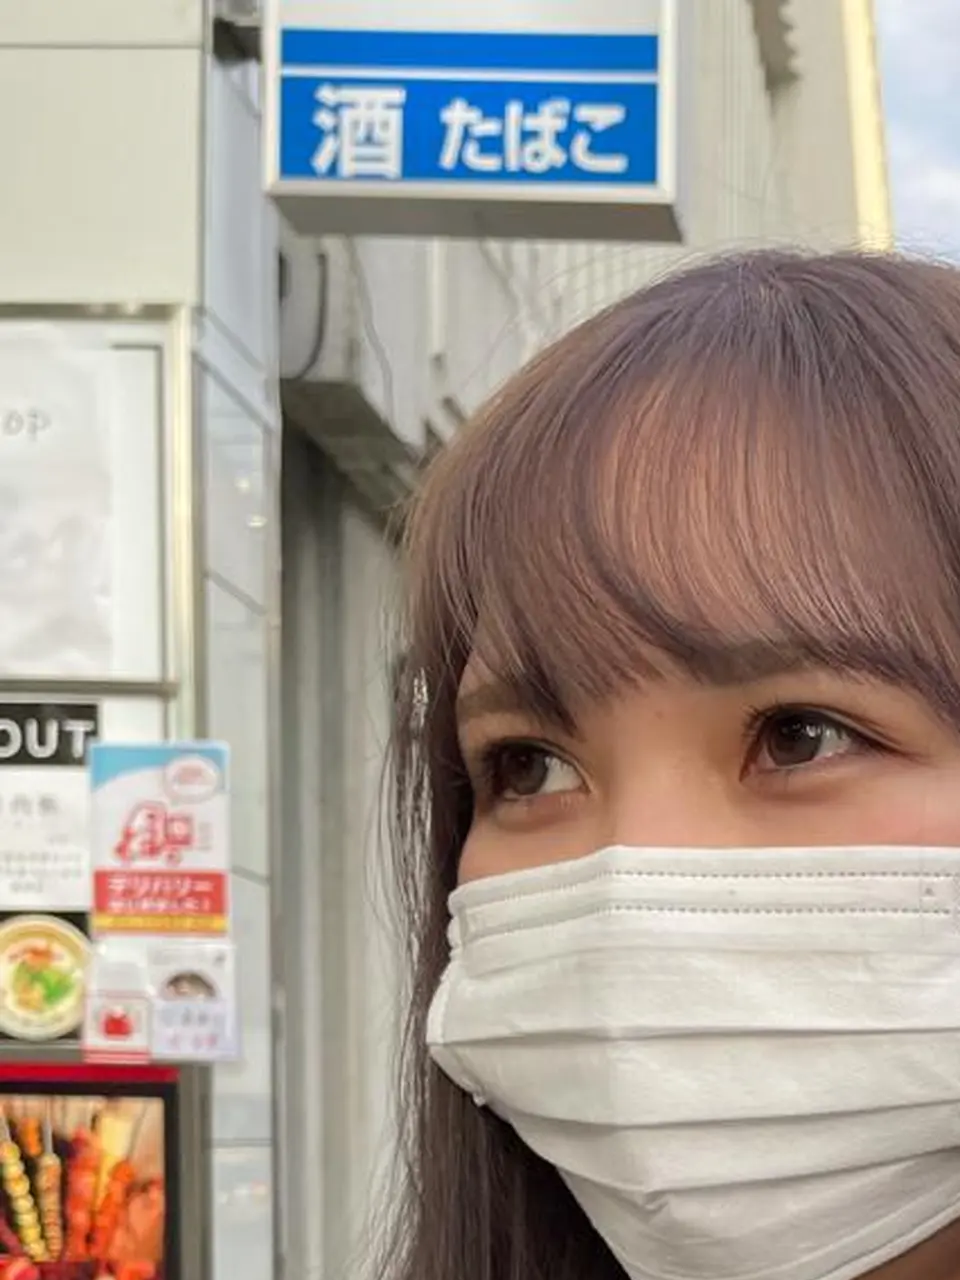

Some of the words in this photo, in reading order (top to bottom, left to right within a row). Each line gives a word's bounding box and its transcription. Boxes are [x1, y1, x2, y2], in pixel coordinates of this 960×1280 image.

[311, 83, 406, 179] 酒
[439, 96, 628, 174] たばこ
[0, 717, 95, 759] OUT
[107, 874, 214, 898] デリバリー
